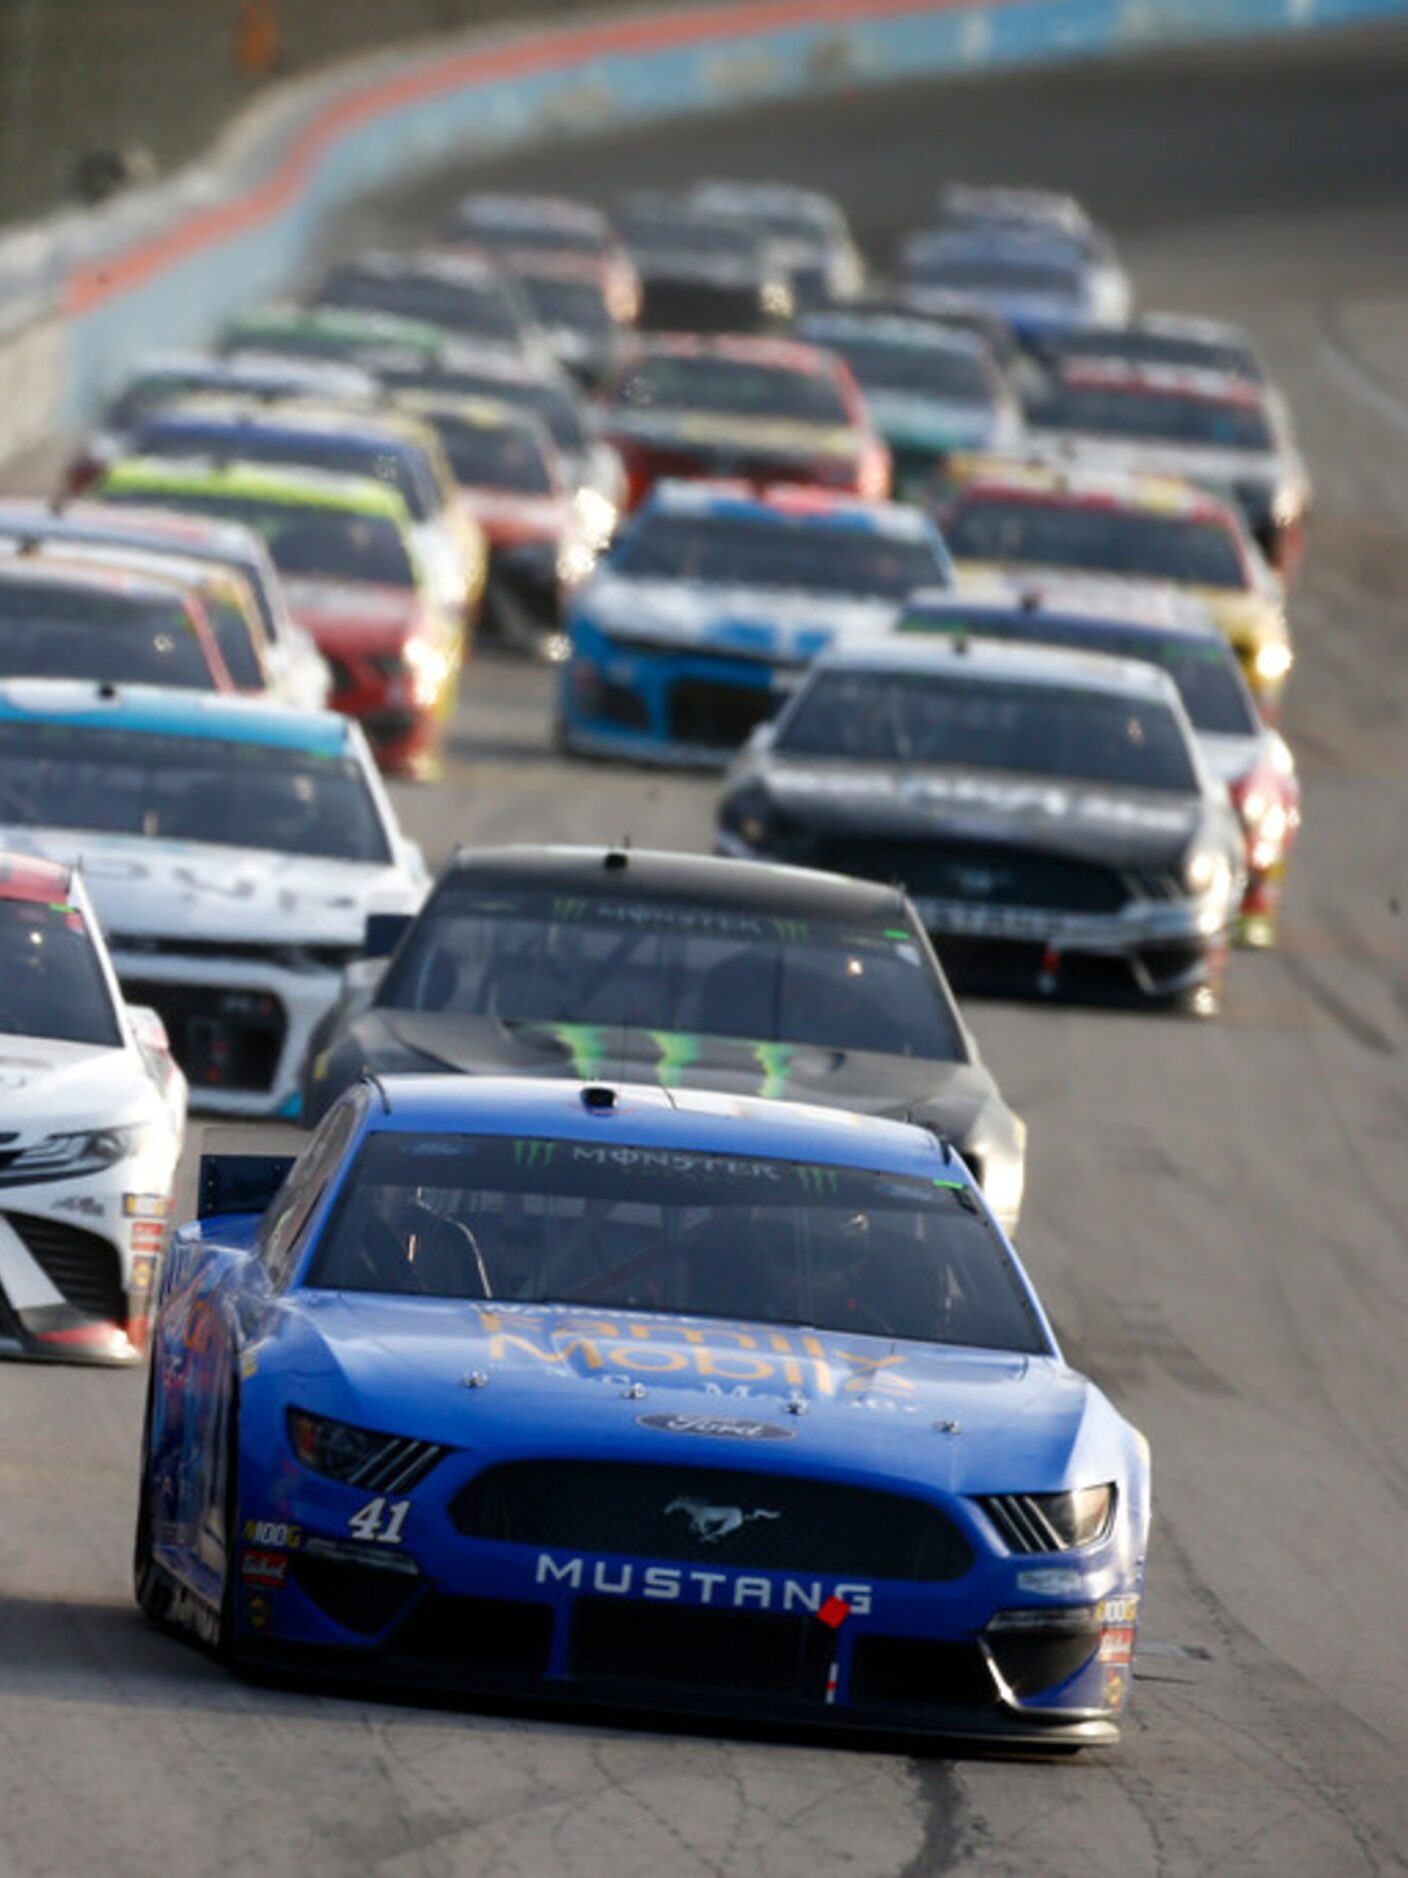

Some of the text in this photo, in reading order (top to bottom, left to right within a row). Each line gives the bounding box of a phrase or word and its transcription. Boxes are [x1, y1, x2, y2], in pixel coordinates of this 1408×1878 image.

[571, 1143, 781, 1181] MONSTER
[490, 1333, 919, 1398] Mobile
[666, 1414, 765, 1437] Ford
[348, 1497, 411, 1544] 41
[534, 1553, 872, 1614] MUSTANG
